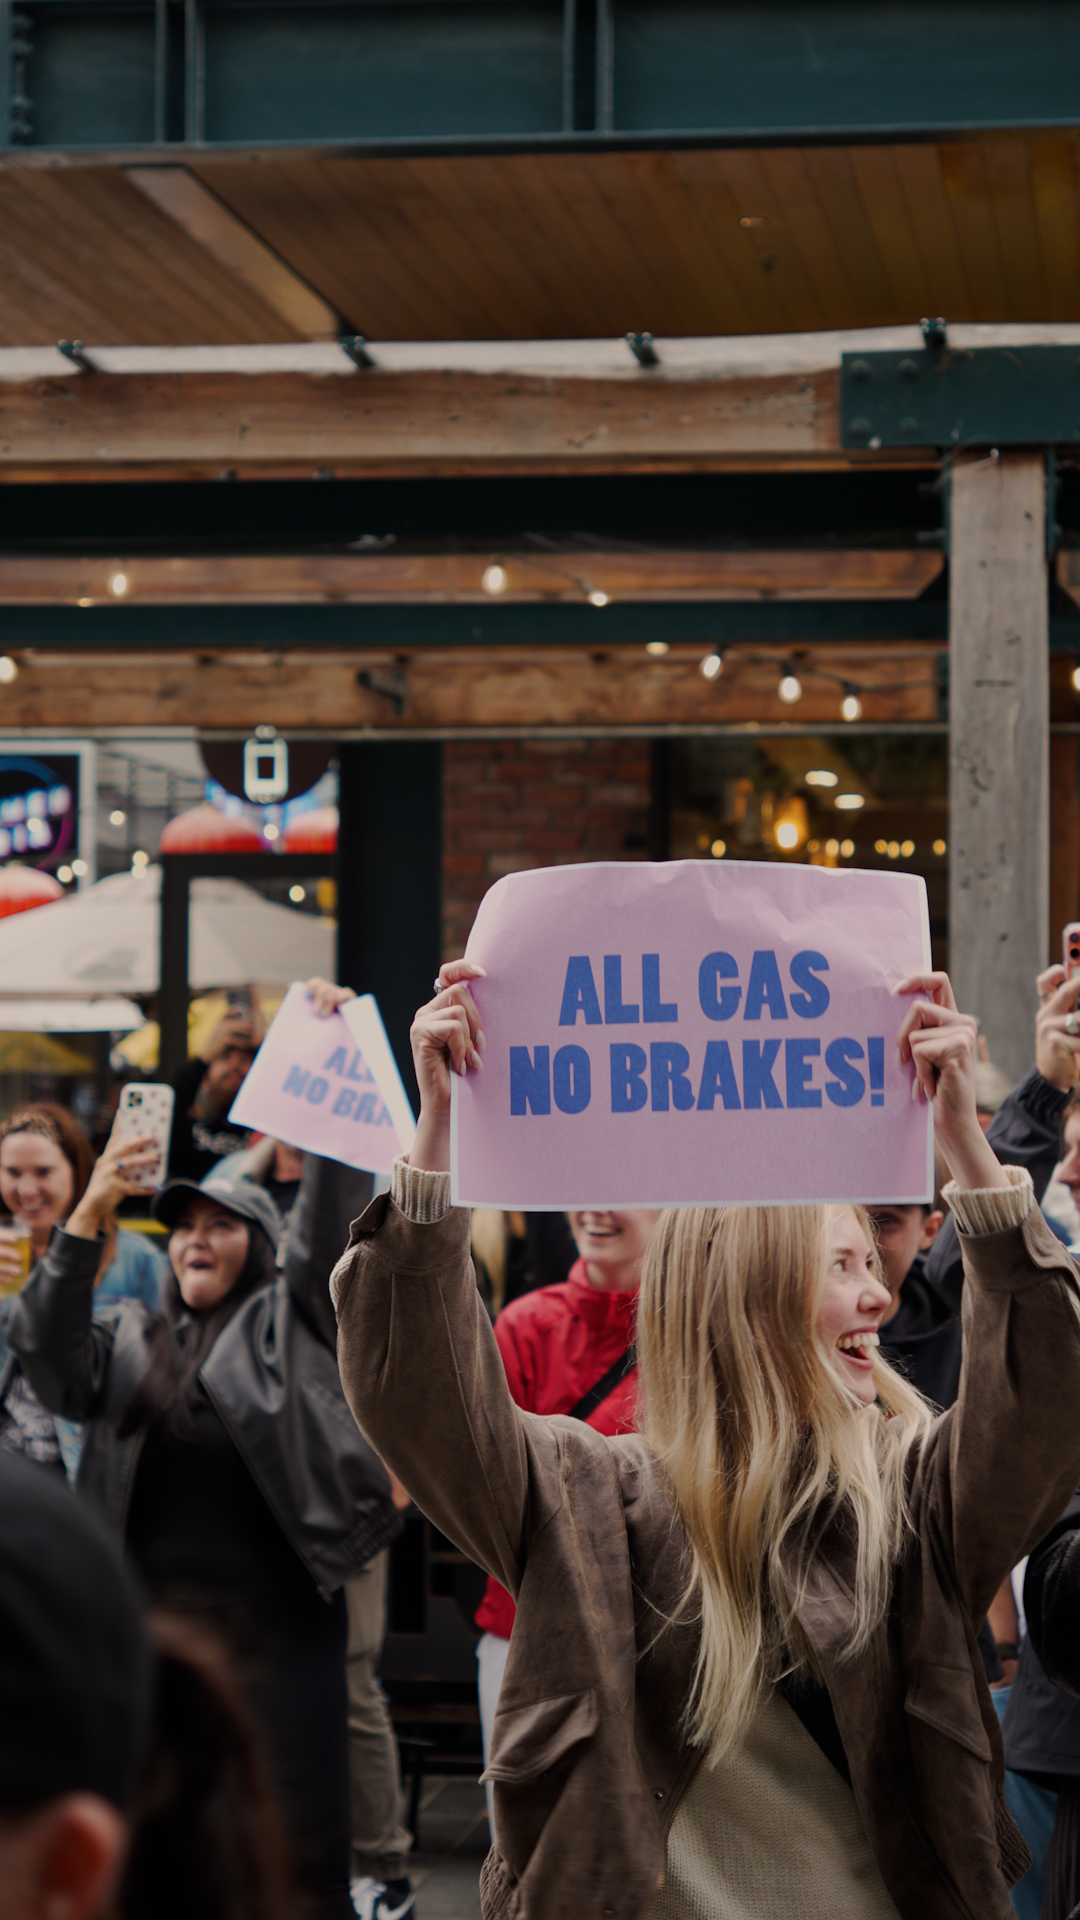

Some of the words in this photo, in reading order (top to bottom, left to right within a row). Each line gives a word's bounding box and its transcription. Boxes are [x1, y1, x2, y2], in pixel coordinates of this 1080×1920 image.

[559, 953, 678, 1026] ALL
[698, 950, 831, 1022] GAS
[282, 1064, 330, 1106] NO
[509, 1044, 592, 1116] NO
[609, 1036, 885, 1114] BRAKES!
